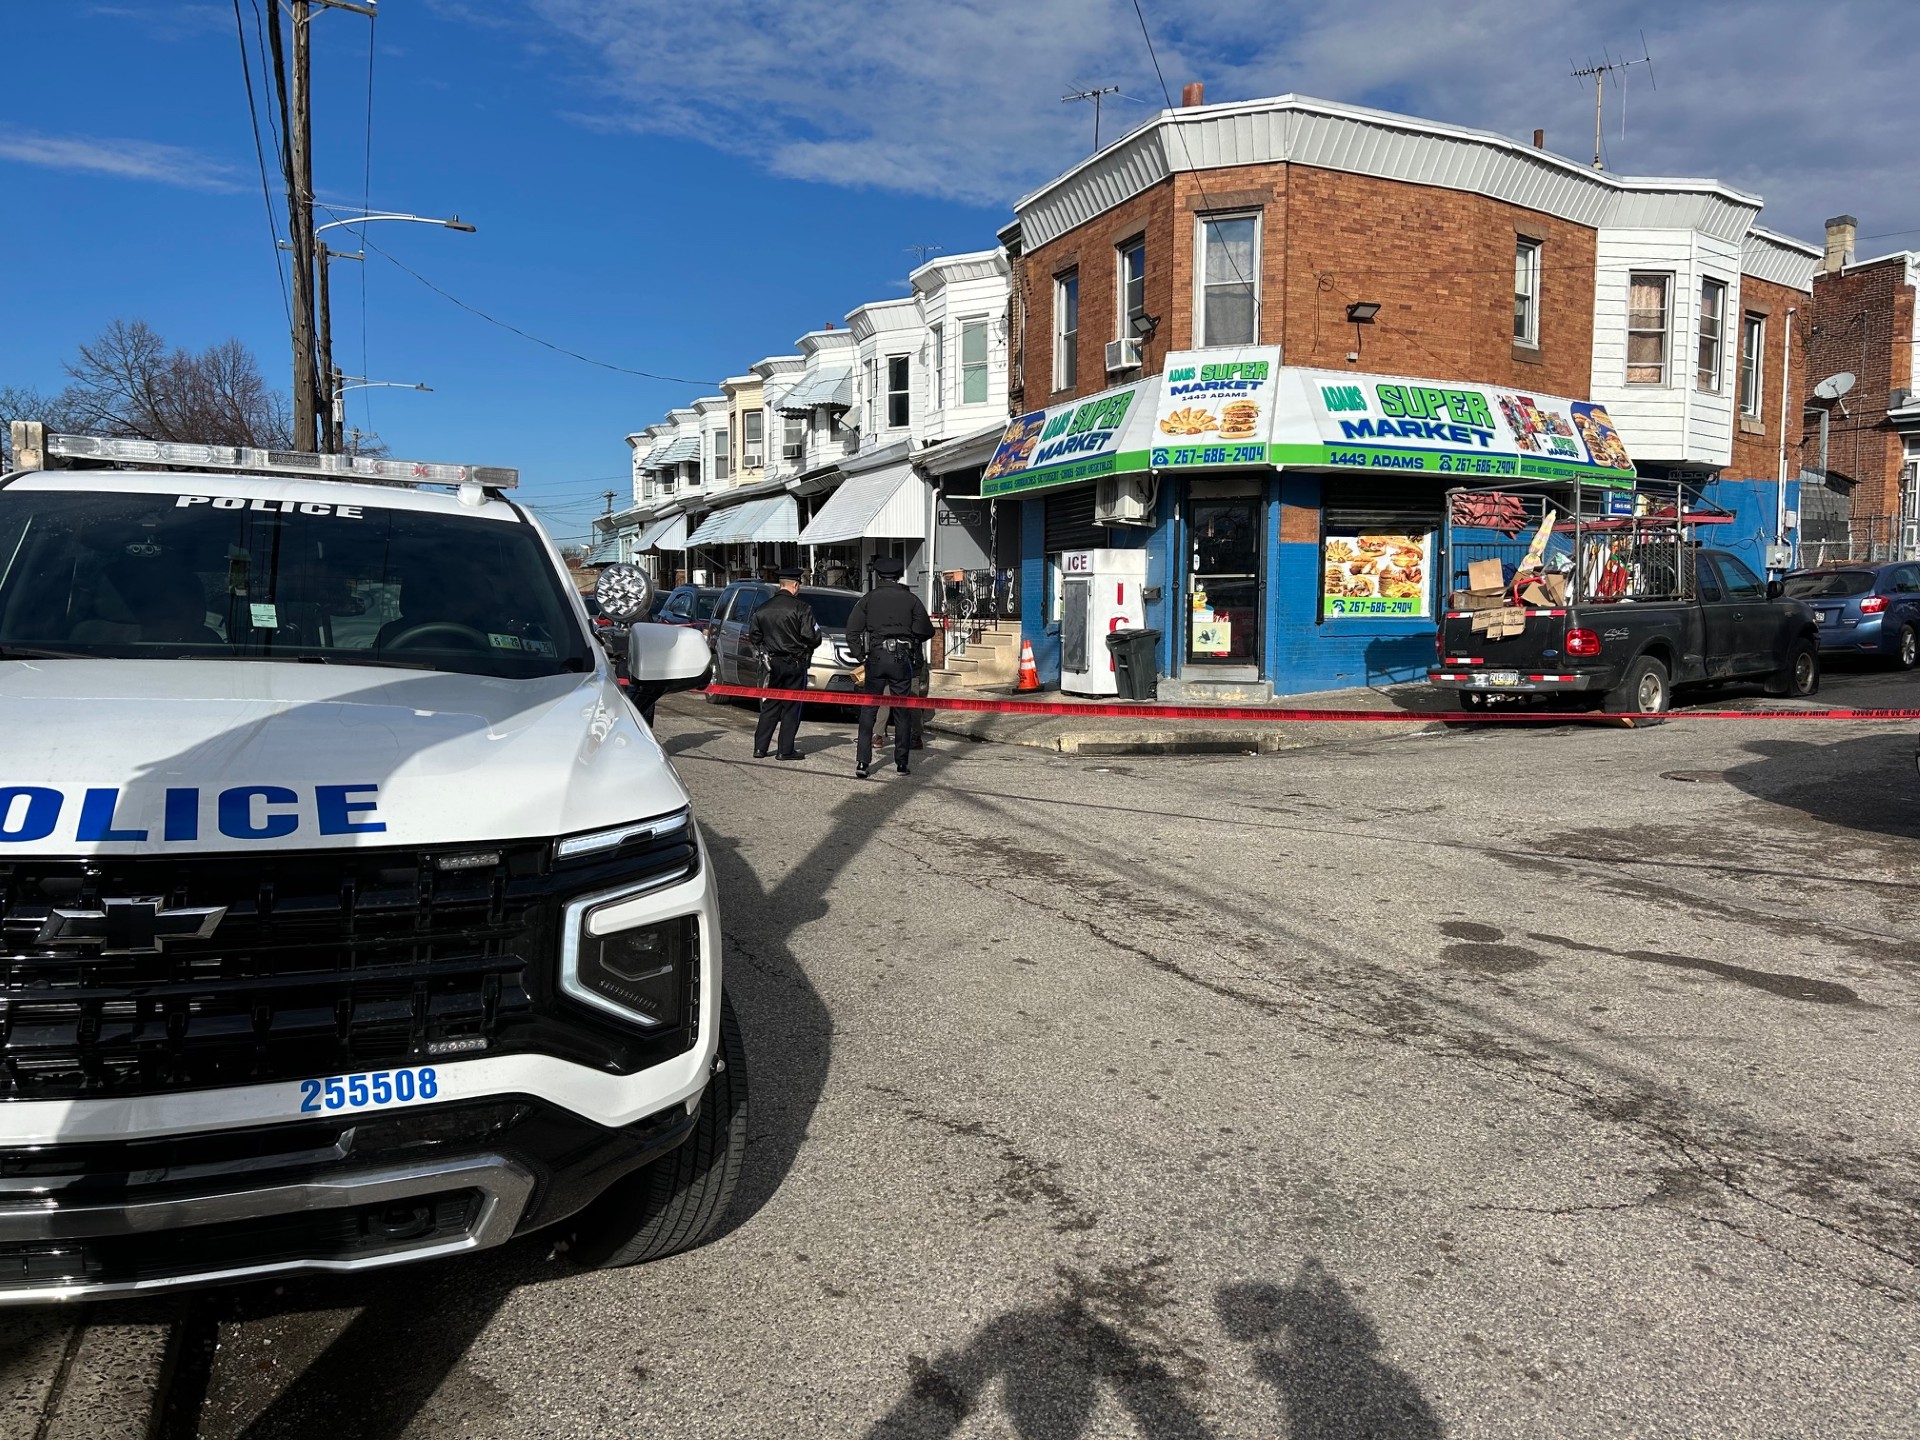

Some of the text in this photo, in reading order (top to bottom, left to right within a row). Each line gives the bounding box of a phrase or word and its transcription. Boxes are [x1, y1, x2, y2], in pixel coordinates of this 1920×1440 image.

[1168, 361, 1269, 382] ADAMS SUPER
[1170, 381, 1264, 396] MARKET
[1067, 389, 1135, 437] SUPER
[1321, 383, 1496, 430] ADAMS SUPER
[1338, 418, 1495, 448] MARKET
[1033, 431, 1114, 466] MARKET
[1174, 446, 1264, 464] 267-686-2904
[1330, 452, 1424, 469] 1443 ADAMS
[1455, 458, 1516, 475] 267-686-2904
[175, 495, 364, 519] POLICE
[1068, 555, 1087, 571] ICE
[1348, 602, 1413, 612] 267-686-2904
[0, 784, 387, 842] OLICE
[300, 1067, 438, 1113] 255508
